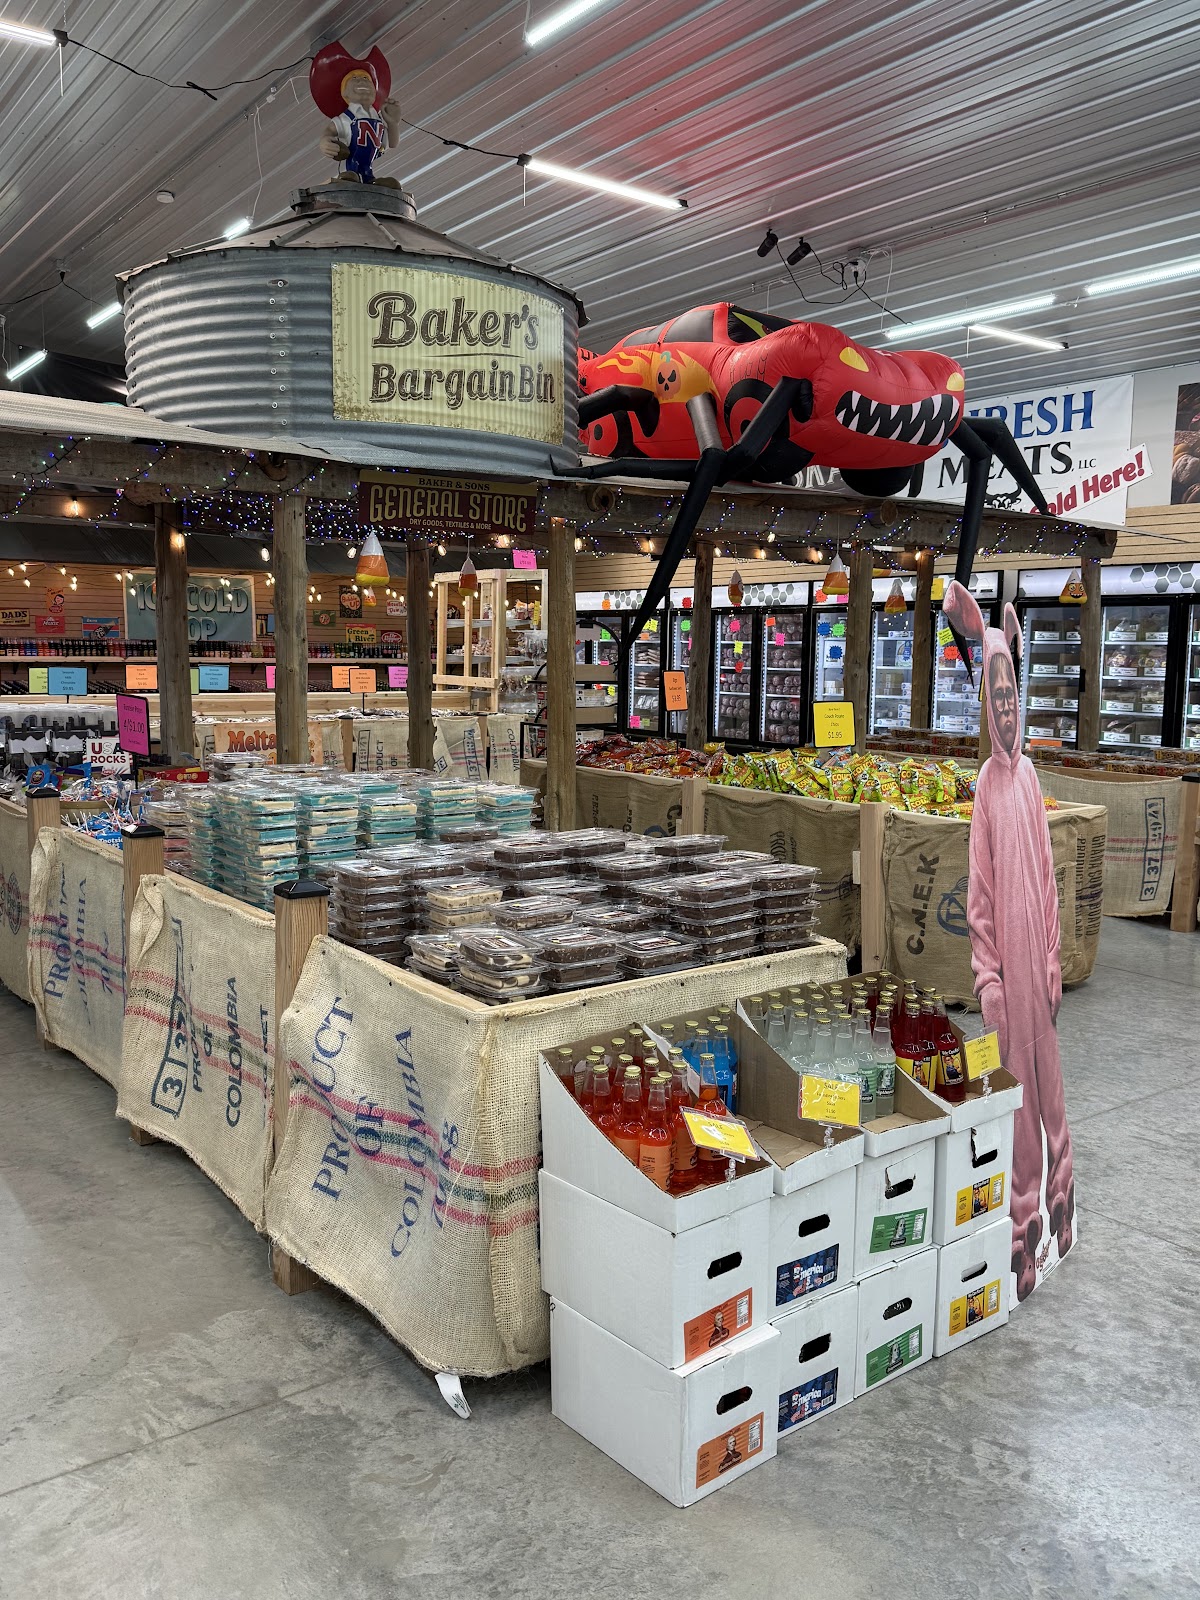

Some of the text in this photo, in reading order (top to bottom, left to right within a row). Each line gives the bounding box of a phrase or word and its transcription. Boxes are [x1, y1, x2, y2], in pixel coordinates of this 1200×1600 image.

[357, 120, 385, 149] N
[367, 290, 539, 348] Baker's
[370, 359, 556, 410] Bargain Bin
[968, 390, 1096, 440] ESH
[418, 477, 490, 491] BAKER & SONS
[937, 441, 1097, 489] MTS, LLC
[1082, 450, 1146, 504] Here!
[369, 484, 528, 532] GENERAL STORE
[409, 518, 421, 526] DRY
[422, 519, 444, 528] GOODS,
[445, 520, 469, 529] TEXTILES
[136, 582, 249, 614] IC COLD
[187, 616, 218, 641] OP
[90, 755, 126, 764] ROCKS
[91, 741, 121, 755] USA
[506, 728, 520, 772] COLOMBIA
[1147, 857, 1160, 876] 37
[1143, 886, 1155, 896] 3
[203, 1022, 213, 1058] OF
[226, 976, 243, 1128] COLOMBIA
[162, 1076, 183, 1098] 3
[311, 996, 354, 1203] PROUCT
[354, 1096, 384, 1158] OF
[390, 1026, 427, 1259] COLOMBIA
